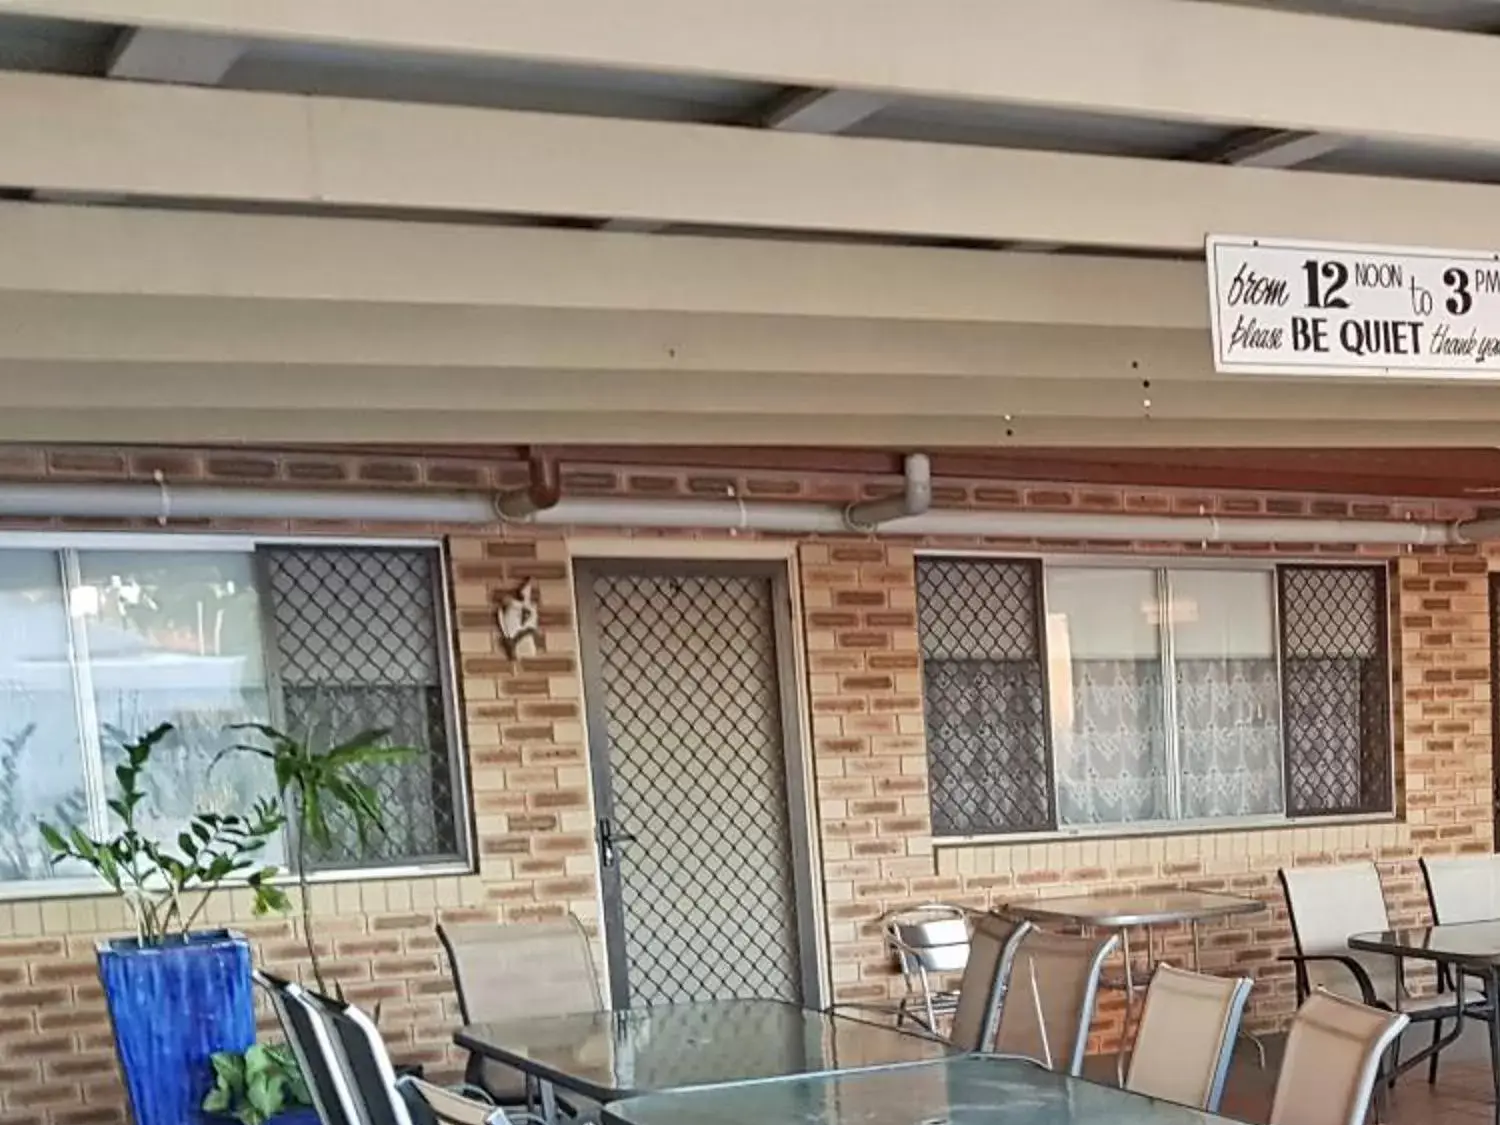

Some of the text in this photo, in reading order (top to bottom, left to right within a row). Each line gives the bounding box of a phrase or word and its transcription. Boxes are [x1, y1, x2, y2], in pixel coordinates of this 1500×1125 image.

[1228, 262, 1290, 307] from
[1302, 260, 1351, 309] 12
[1355, 263, 1403, 289] NOON
[1409, 275, 1433, 316] to
[1443, 268, 1472, 315] 3
[1228, 315, 1284, 354] please
[1291, 317, 1330, 353] BE
[1339, 320, 1424, 356] QUIET
[1430, 323, 1476, 356] thank
